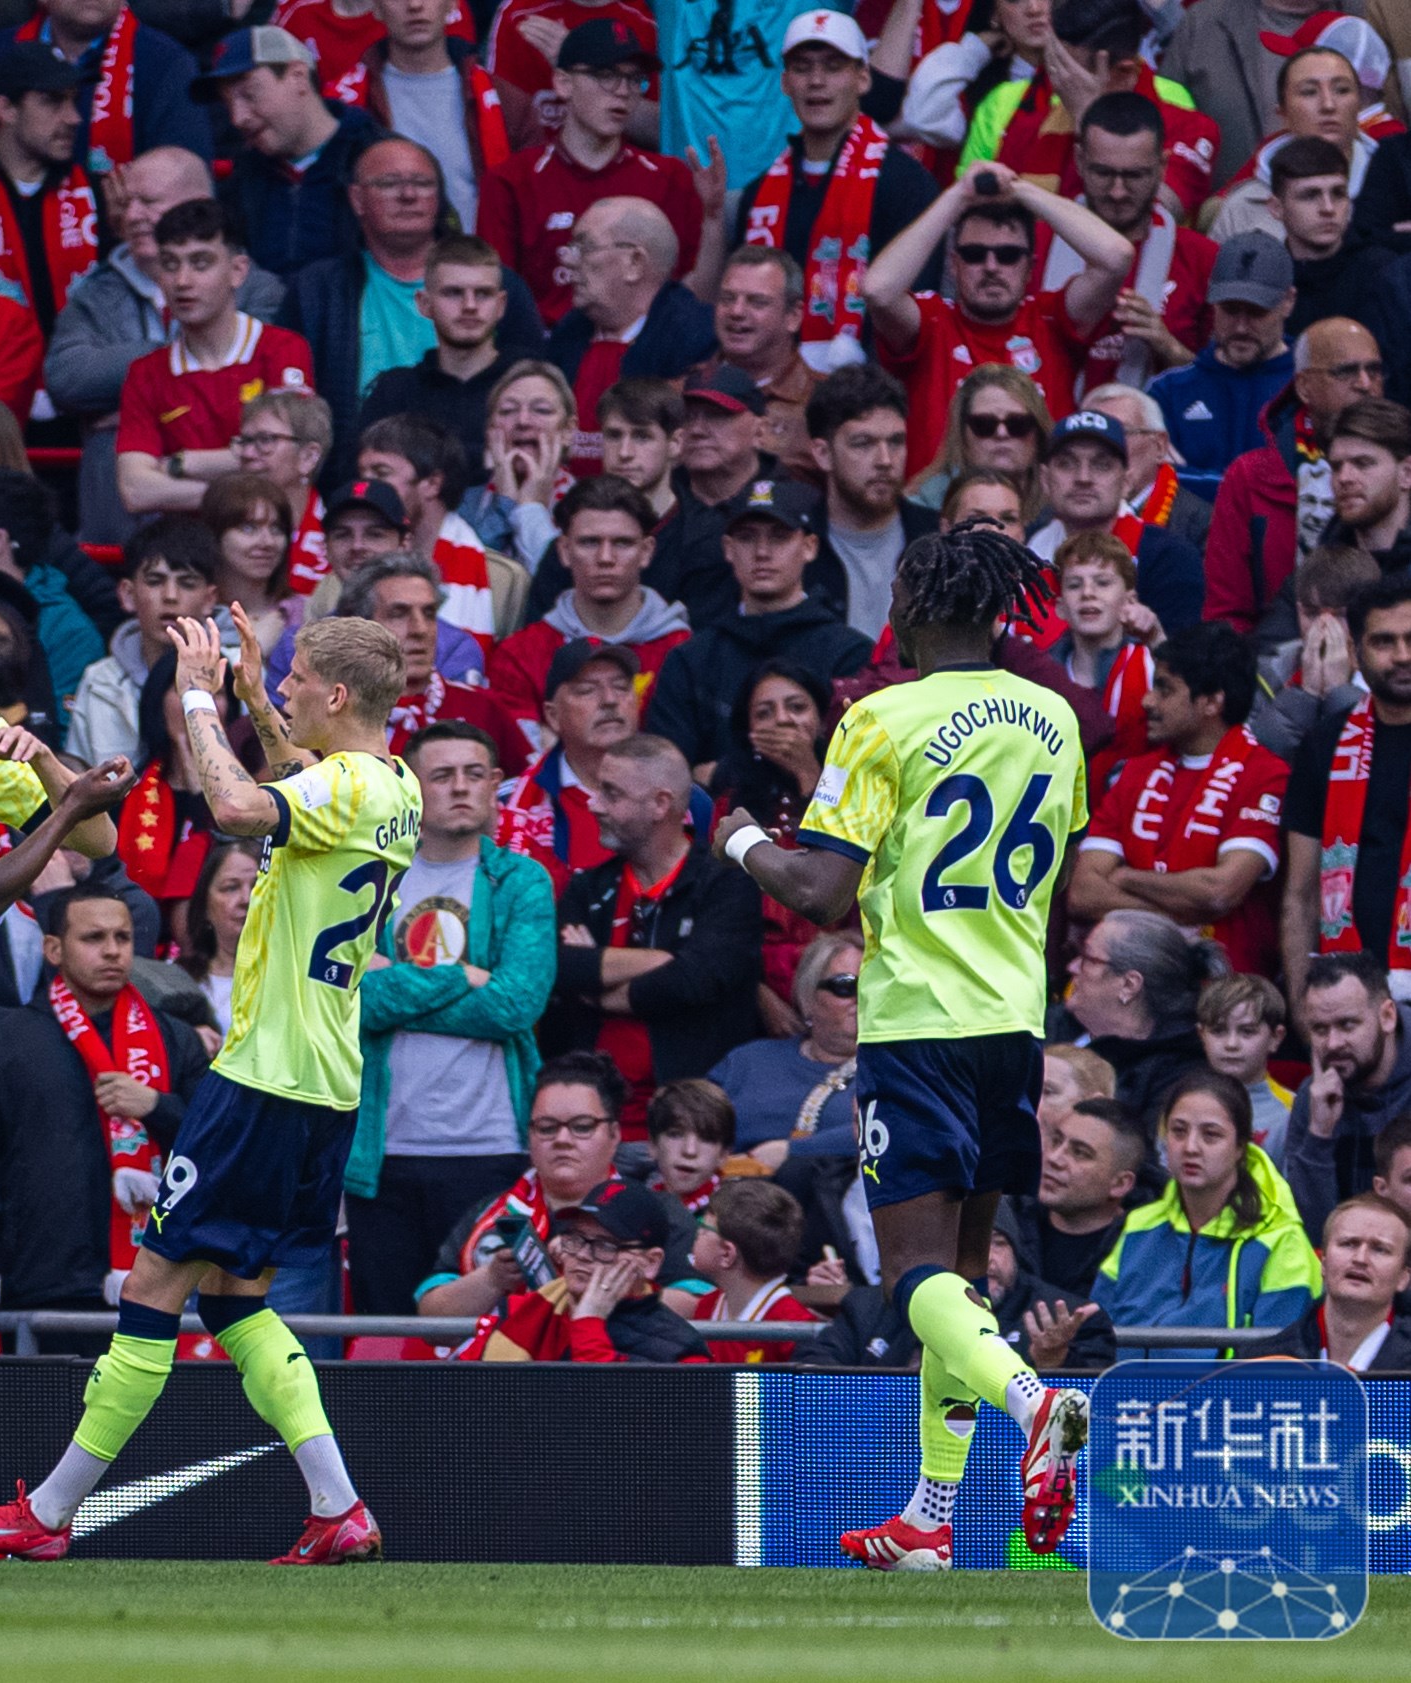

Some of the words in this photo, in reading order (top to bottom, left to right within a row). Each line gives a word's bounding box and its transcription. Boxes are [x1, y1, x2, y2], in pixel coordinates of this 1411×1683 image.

[924, 698, 1064, 767] UGOCHUKWU
[921, 773, 1056, 913] 26
[858, 1100, 890, 1164] 6
[155, 1149, 198, 1211] 9
